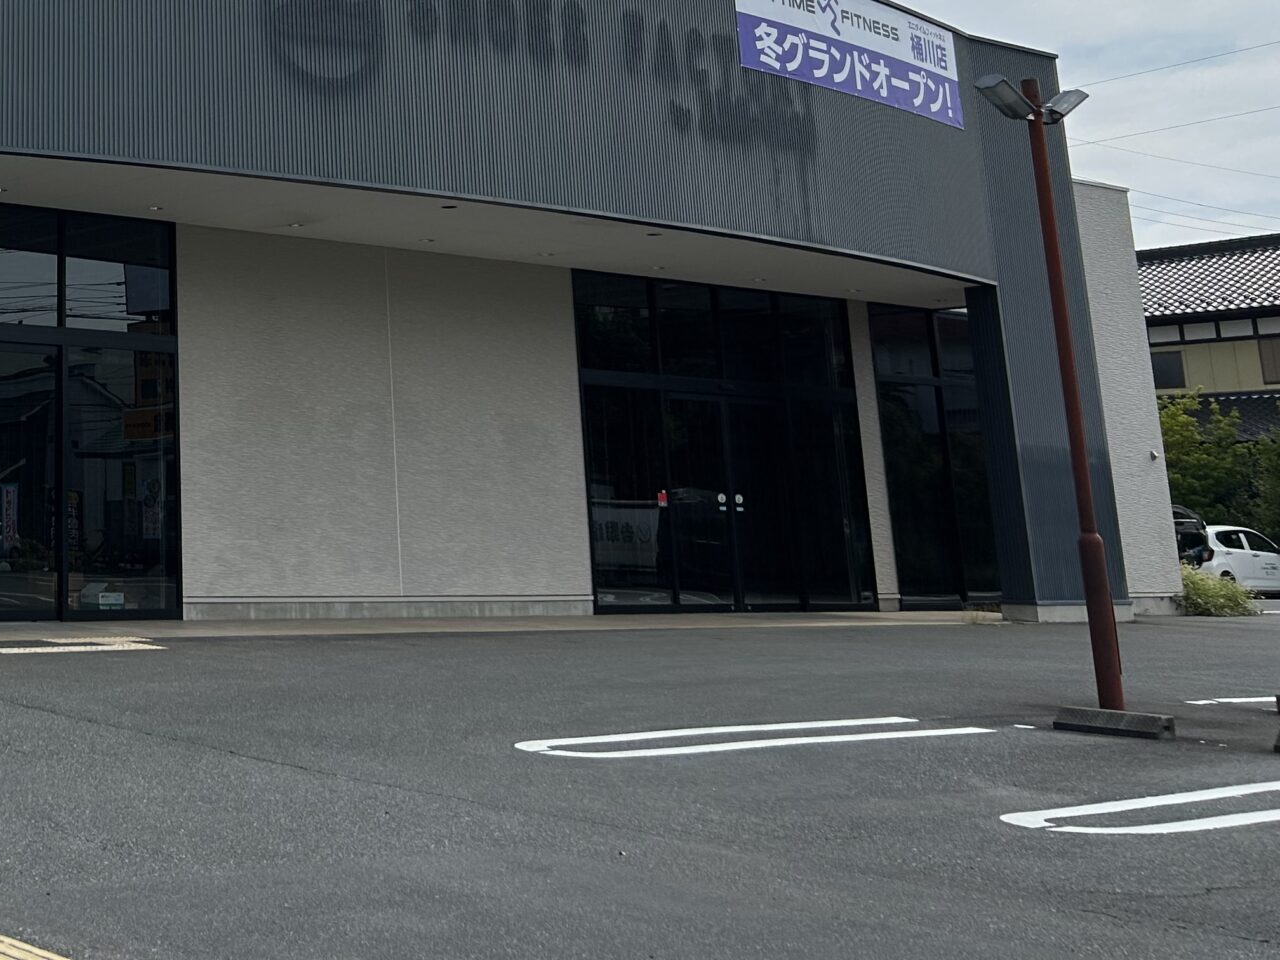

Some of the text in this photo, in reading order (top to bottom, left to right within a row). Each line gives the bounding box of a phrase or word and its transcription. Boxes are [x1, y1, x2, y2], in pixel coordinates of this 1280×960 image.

[840, 9, 900, 42] FITNESS
[910, 32, 948, 71] 桶川店
